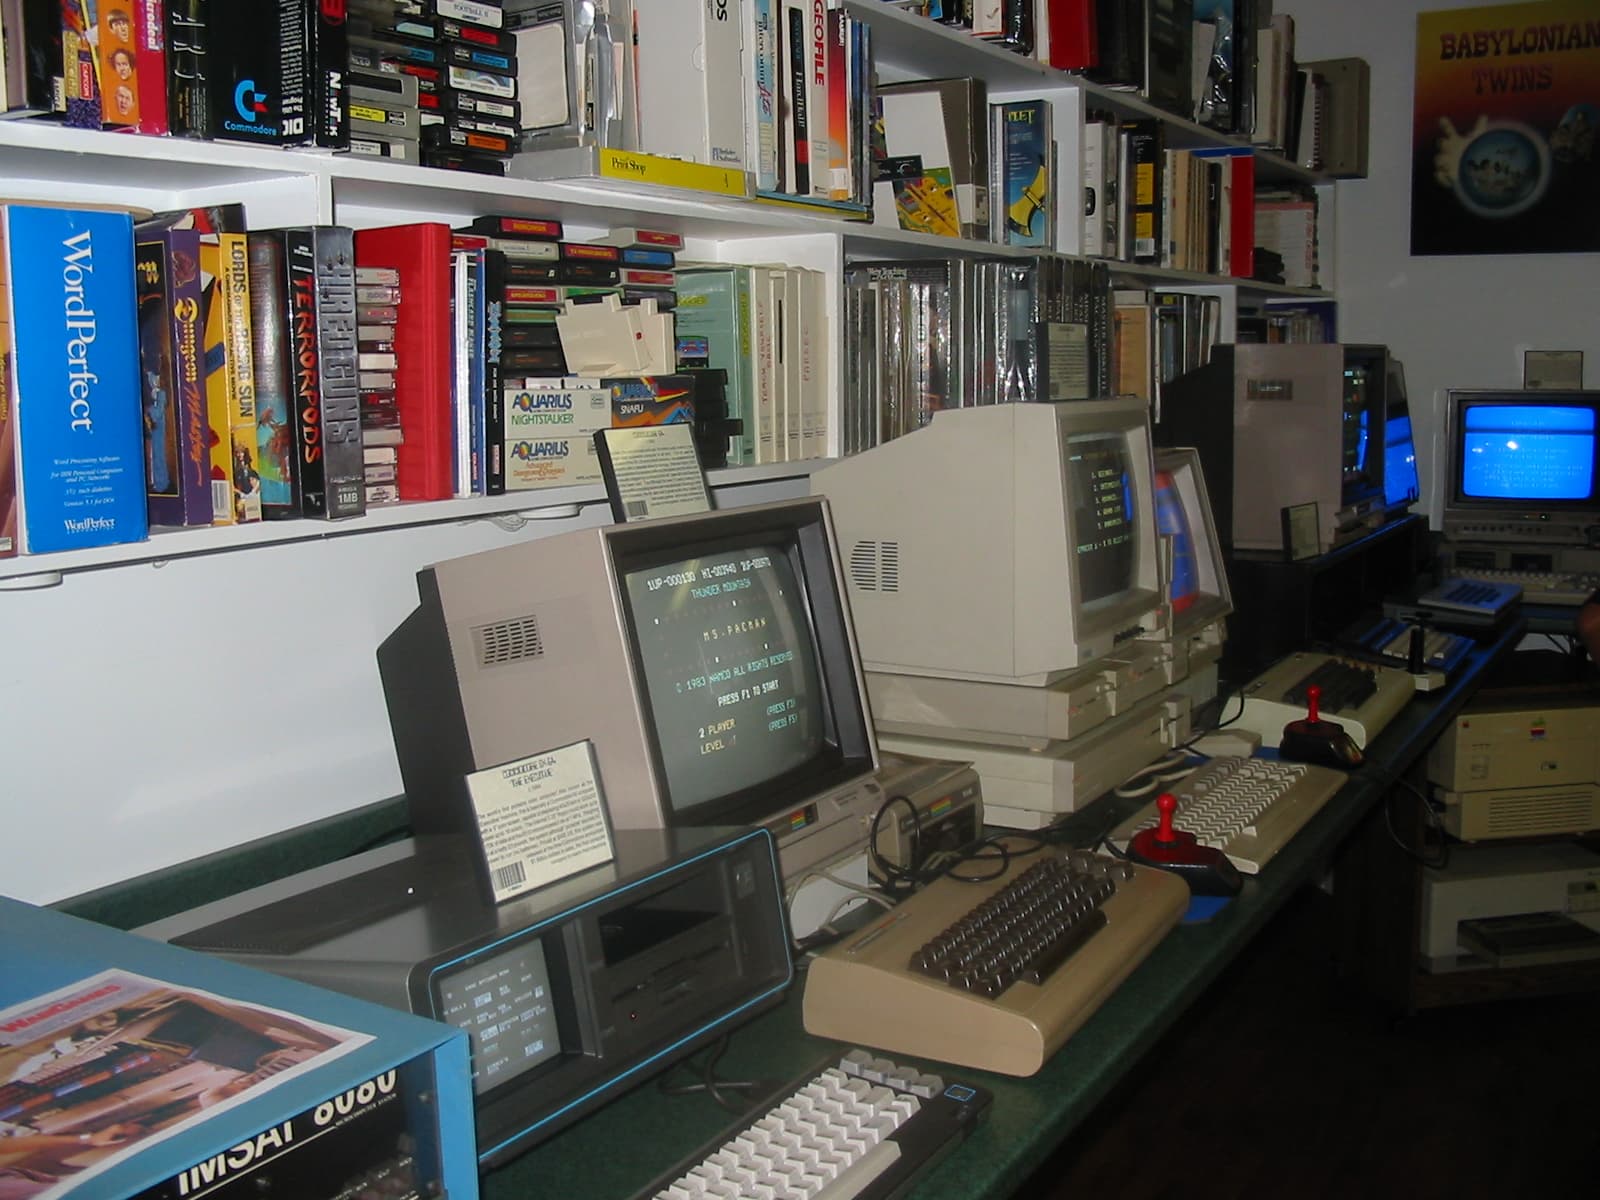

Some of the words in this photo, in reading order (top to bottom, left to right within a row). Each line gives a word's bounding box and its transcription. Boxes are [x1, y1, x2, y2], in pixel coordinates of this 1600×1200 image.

[146, 0, 162, 50] icrodeal
[814, 0, 825, 86] GEOFILE
[1439, 21, 1600, 61] BABYLONIAN
[1472, 64, 1553, 96] TWINS
[224, 120, 278, 136] Commodore
[317, 263, 354, 352] HIRED
[62, 231, 98, 434] WordPerfect
[230, 240, 247, 294] LORDS
[239, 385, 253, 418] SUN
[294, 277, 322, 464] TERRORPODS
[322, 354, 359, 445] GUNS
[512, 392, 573, 413] AQUARIUS
[619, 404, 644, 415] SNAFU
[512, 413, 574, 425] NIGHTSTALKER
[511, 441, 569, 461] AQUARIUS
[337, 492, 358, 504] 1MB
[64, 516, 115, 531] WordPerfect
[717, 692, 740, 707] PRESS
[762, 679, 780, 694] START
[707, 718, 736, 736] PLAYER
[700, 741, 726, 755] LEVEL
